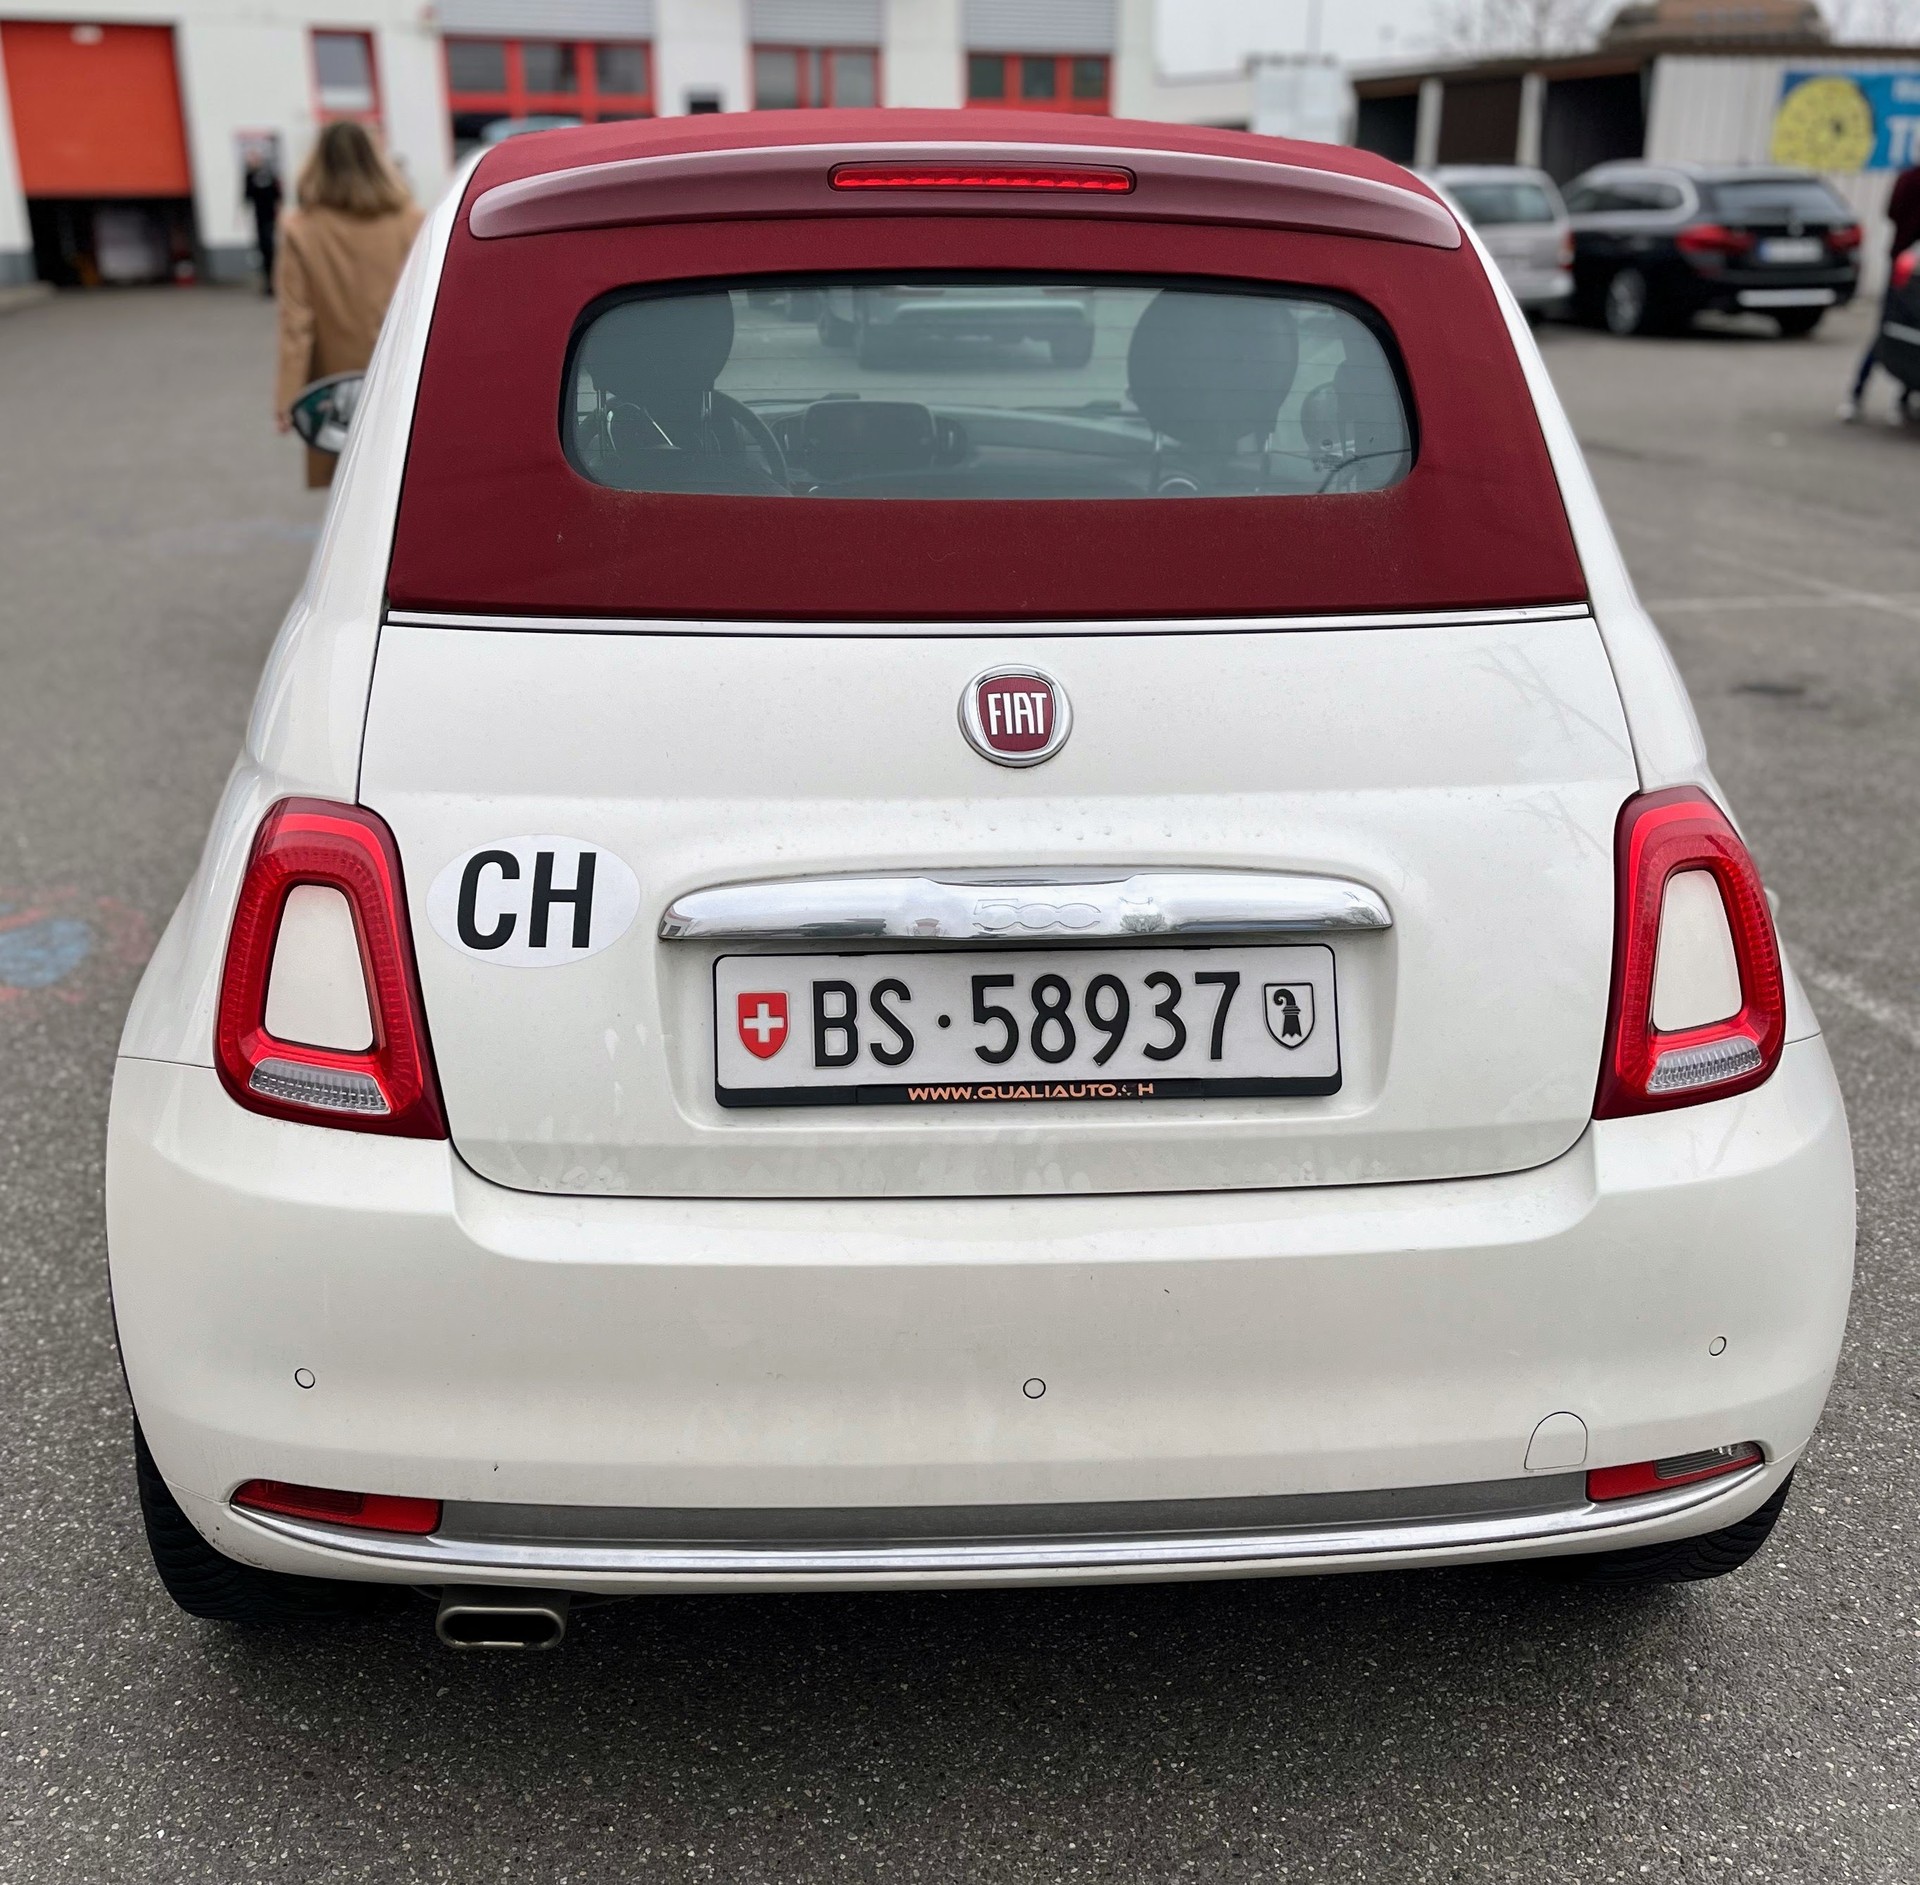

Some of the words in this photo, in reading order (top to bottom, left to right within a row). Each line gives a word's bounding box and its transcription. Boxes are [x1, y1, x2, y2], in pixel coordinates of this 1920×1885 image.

[987, 692, 1048, 735] FIAT
[457, 849, 597, 950] CH
[972, 898, 1102, 931] 500
